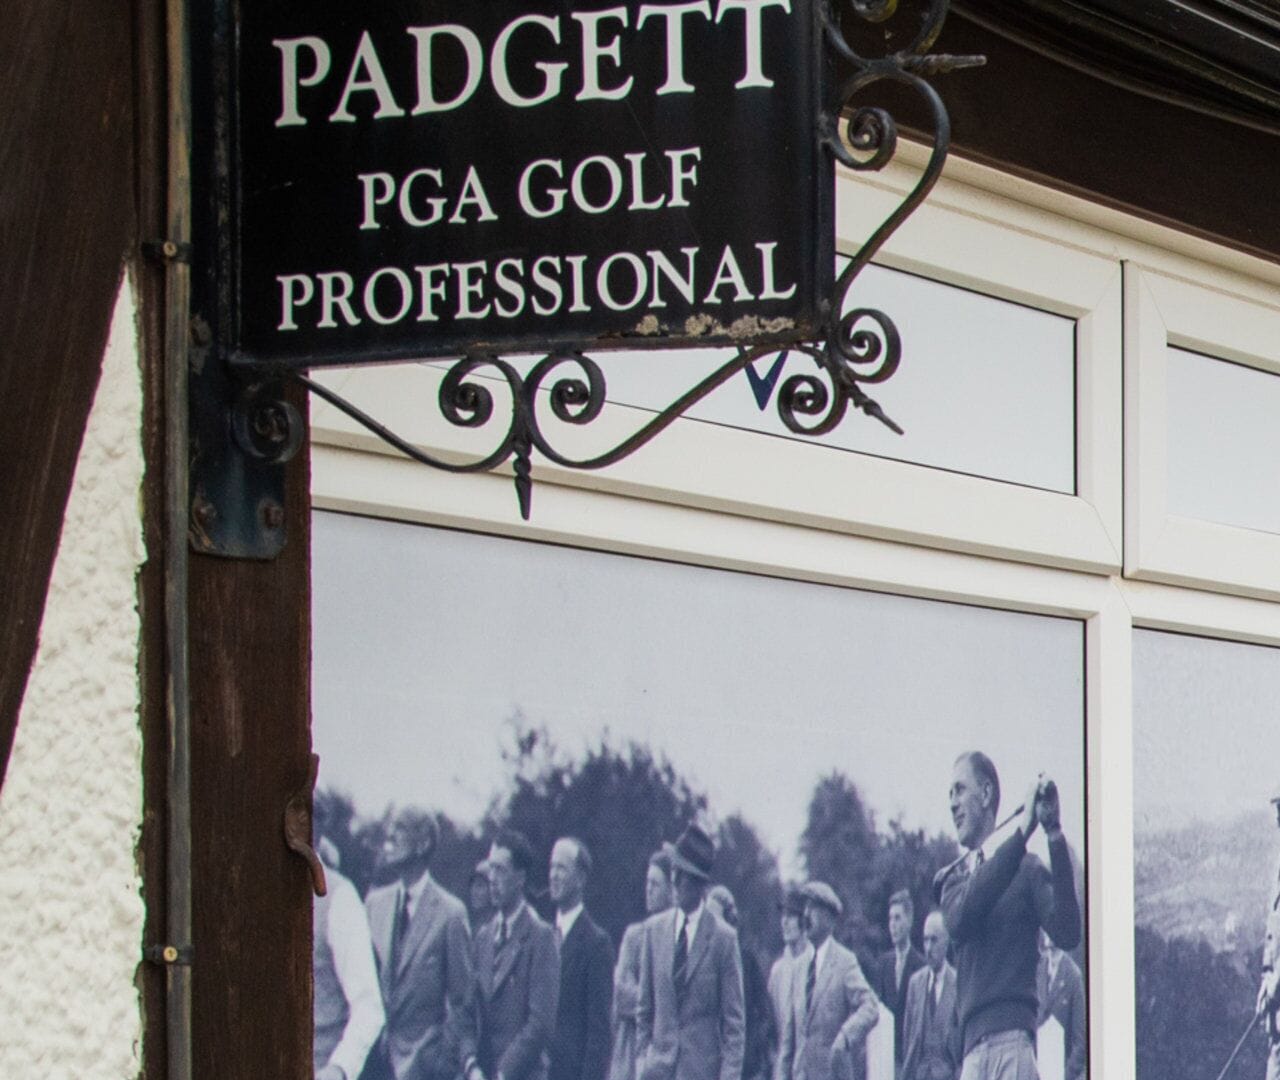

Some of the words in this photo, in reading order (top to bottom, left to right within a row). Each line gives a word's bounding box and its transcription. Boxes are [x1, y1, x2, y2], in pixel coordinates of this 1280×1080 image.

[272, 0, 792, 128] PADGETT
[357, 165, 498, 230] PGA
[518, 147, 702, 219] GOLF
[276, 242, 797, 331] PROFESSIONAL
